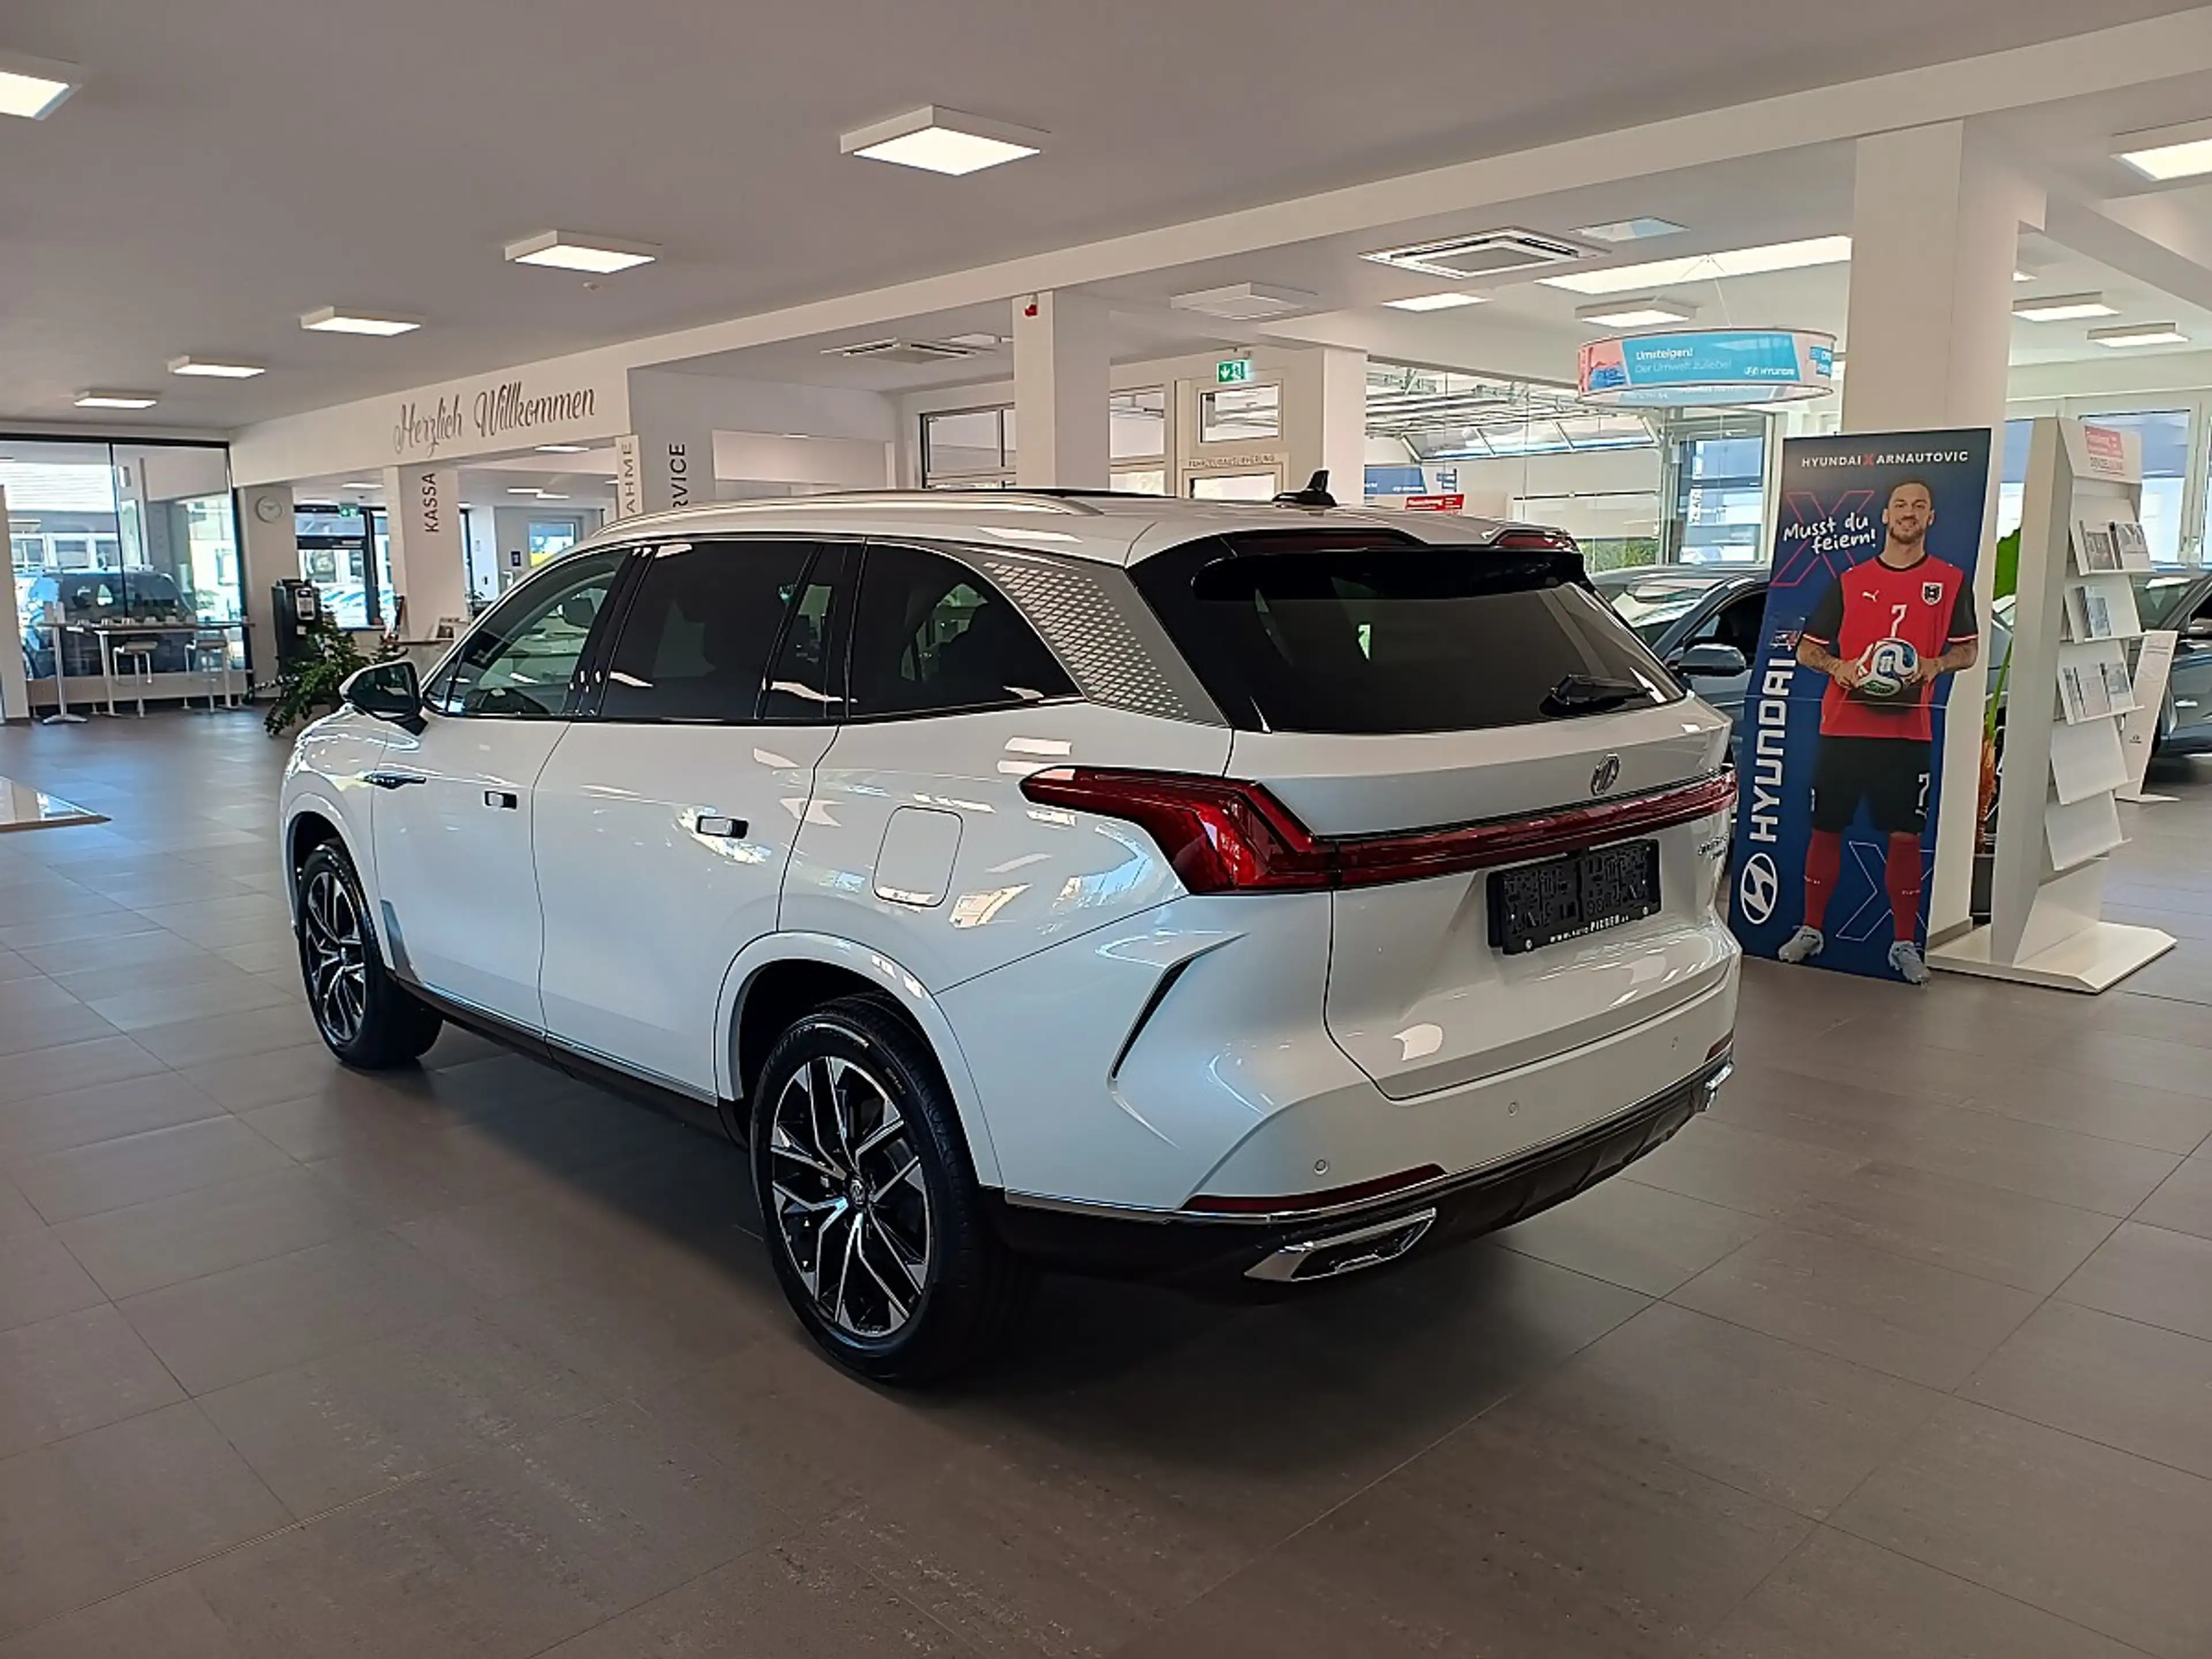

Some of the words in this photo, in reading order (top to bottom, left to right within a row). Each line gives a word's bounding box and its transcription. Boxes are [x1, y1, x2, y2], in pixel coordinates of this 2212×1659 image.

[392, 393, 463, 459] Herzlich
[474, 381, 596, 438] Willkommen
[1801, 455, 1861, 467] HYUNDAI
[1876, 452, 1968, 465] ARNAUTOVIC
[421, 473, 440, 533] KASSA
[1783, 516, 1837, 541] Musst
[1844, 512, 1869, 532] du
[1812, 528, 1876, 554] feiern!
[1891, 604, 1908, 638] 7
[1749, 658, 1797, 843] HYUNDAI
